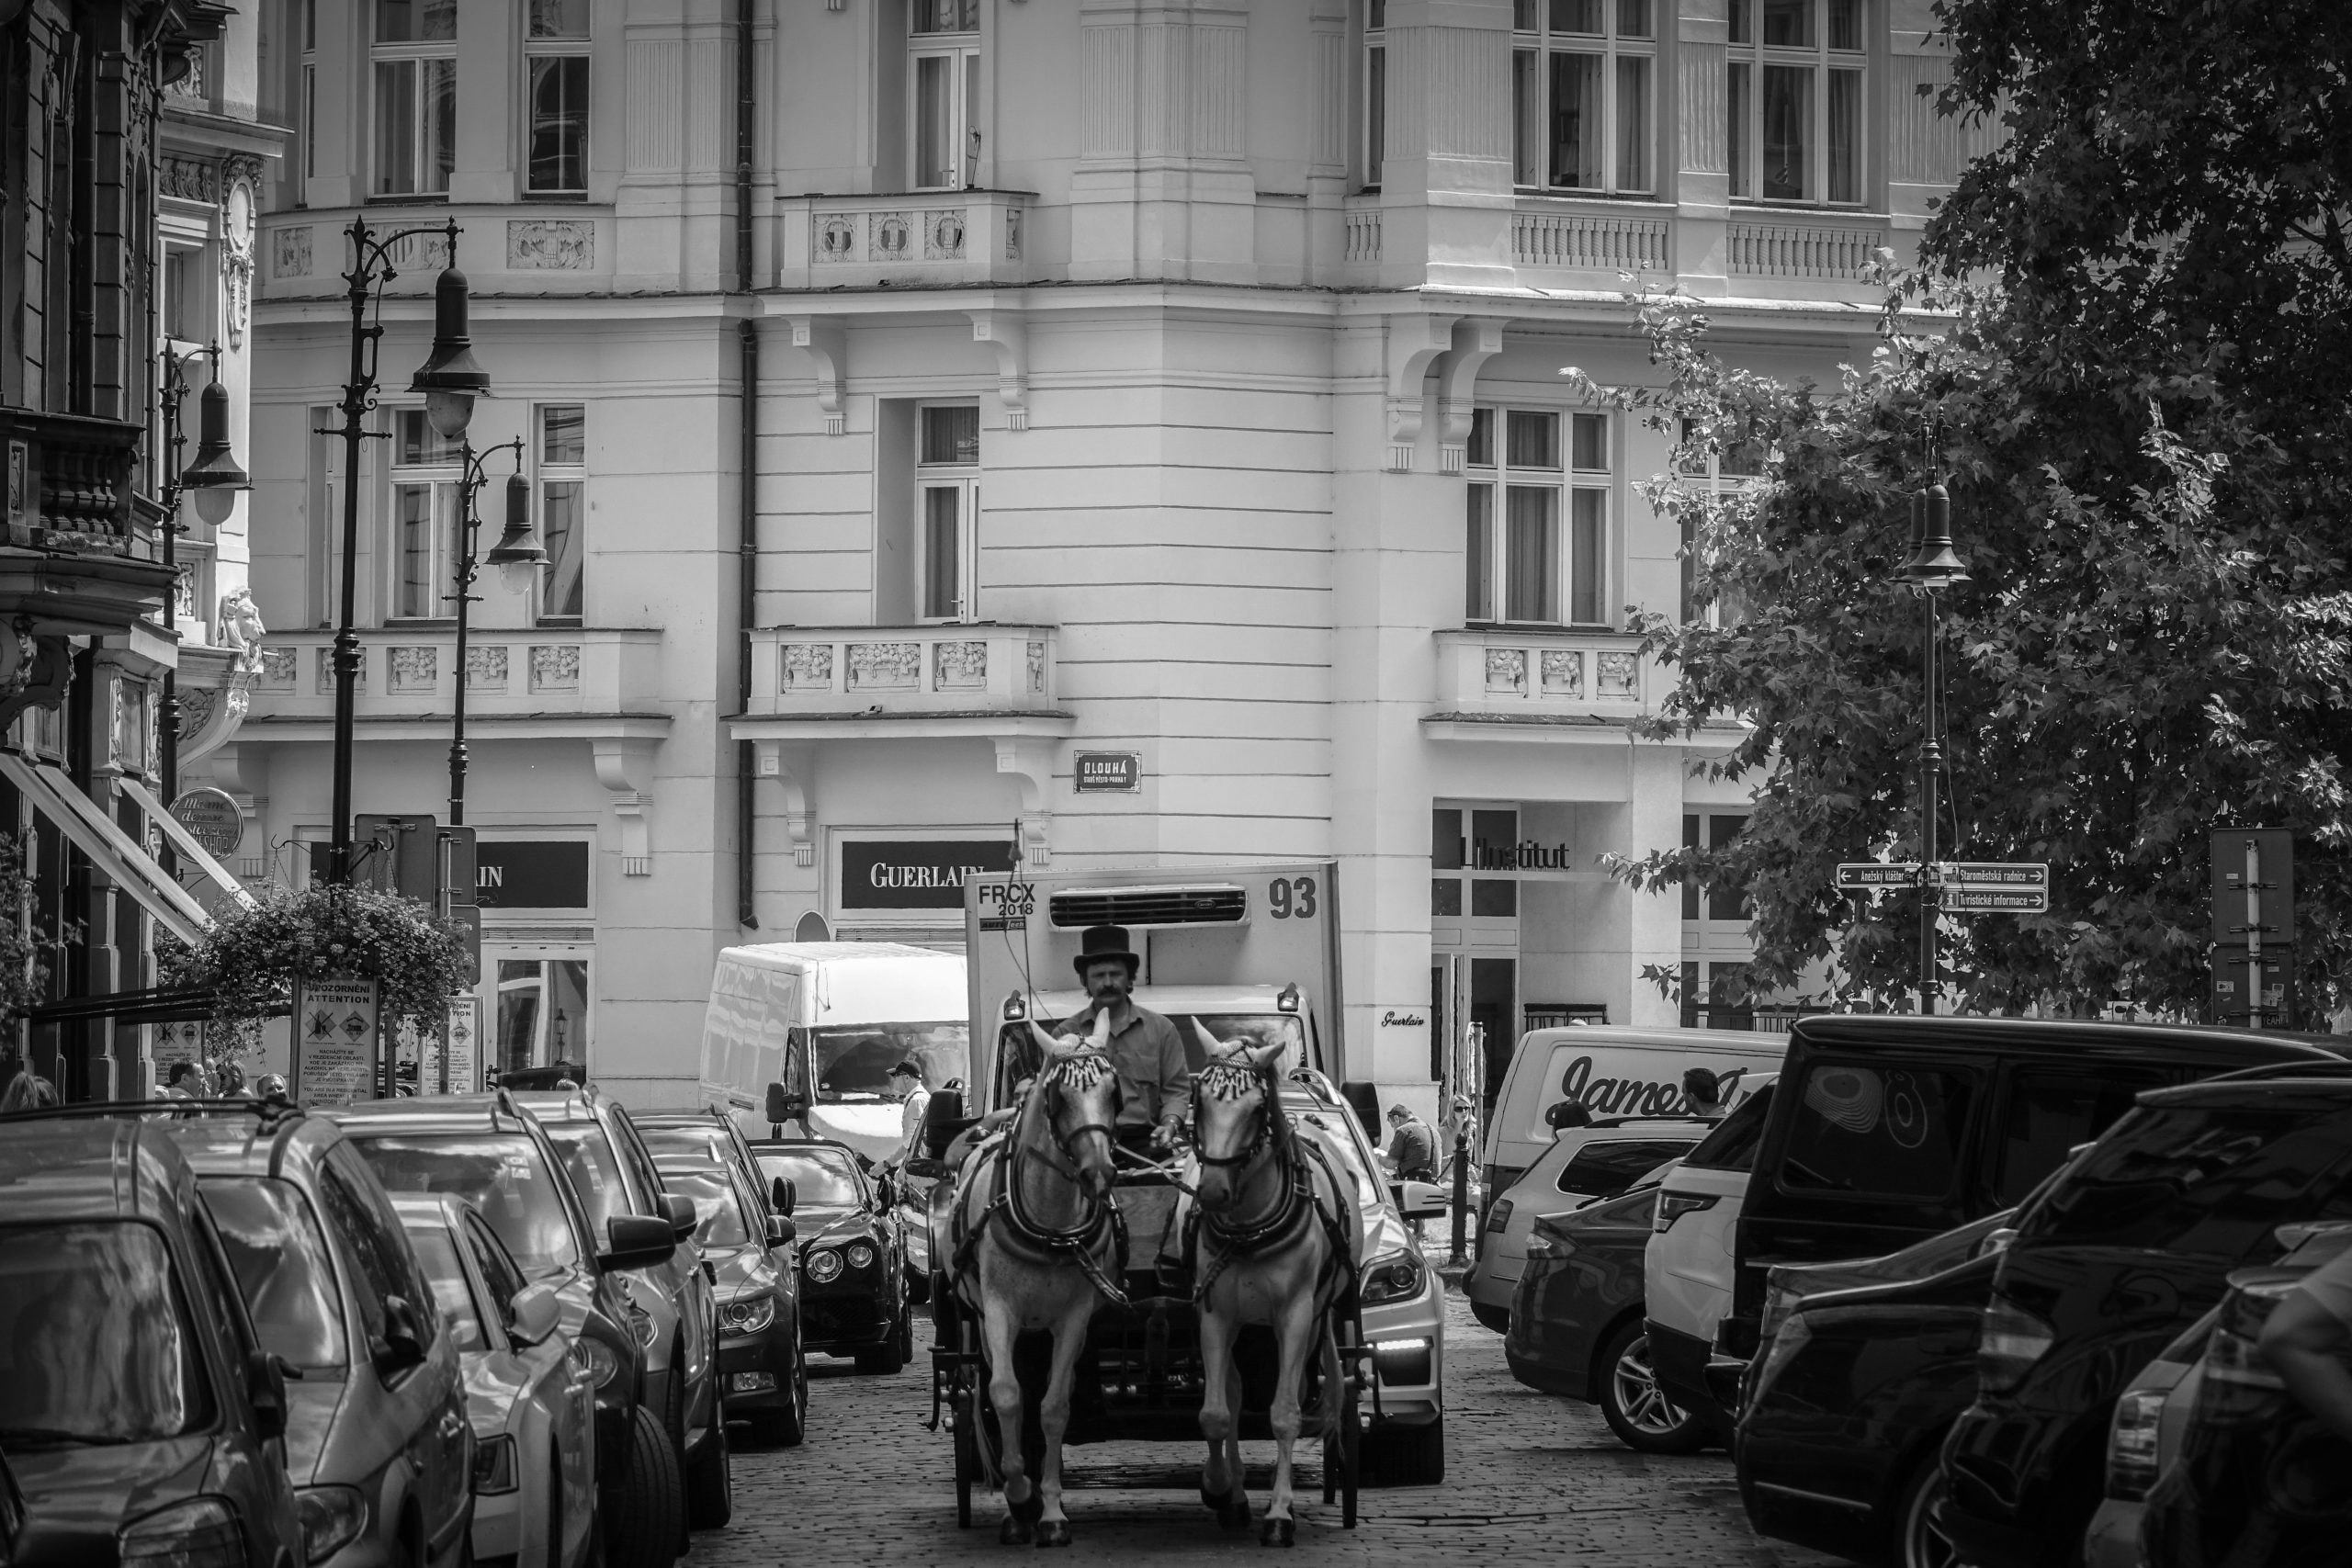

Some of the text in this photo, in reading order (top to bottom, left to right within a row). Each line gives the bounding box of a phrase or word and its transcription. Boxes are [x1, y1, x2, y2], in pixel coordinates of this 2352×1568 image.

[1084, 760, 1126, 774] DLOUHÁ
[1860, 870, 1905, 884] Anežský klášter
[1960, 869, 2027, 882] Staroměstská radnice
[978, 884, 1036, 904] FRCX
[1269, 877, 1317, 919] 93
[1959, 894, 2029, 907] Turistické informace
[998, 904, 1034, 916] 2018
[307, 995, 370, 1004] ATTENTION
[1381, 1010, 1424, 1027] Guerlain
